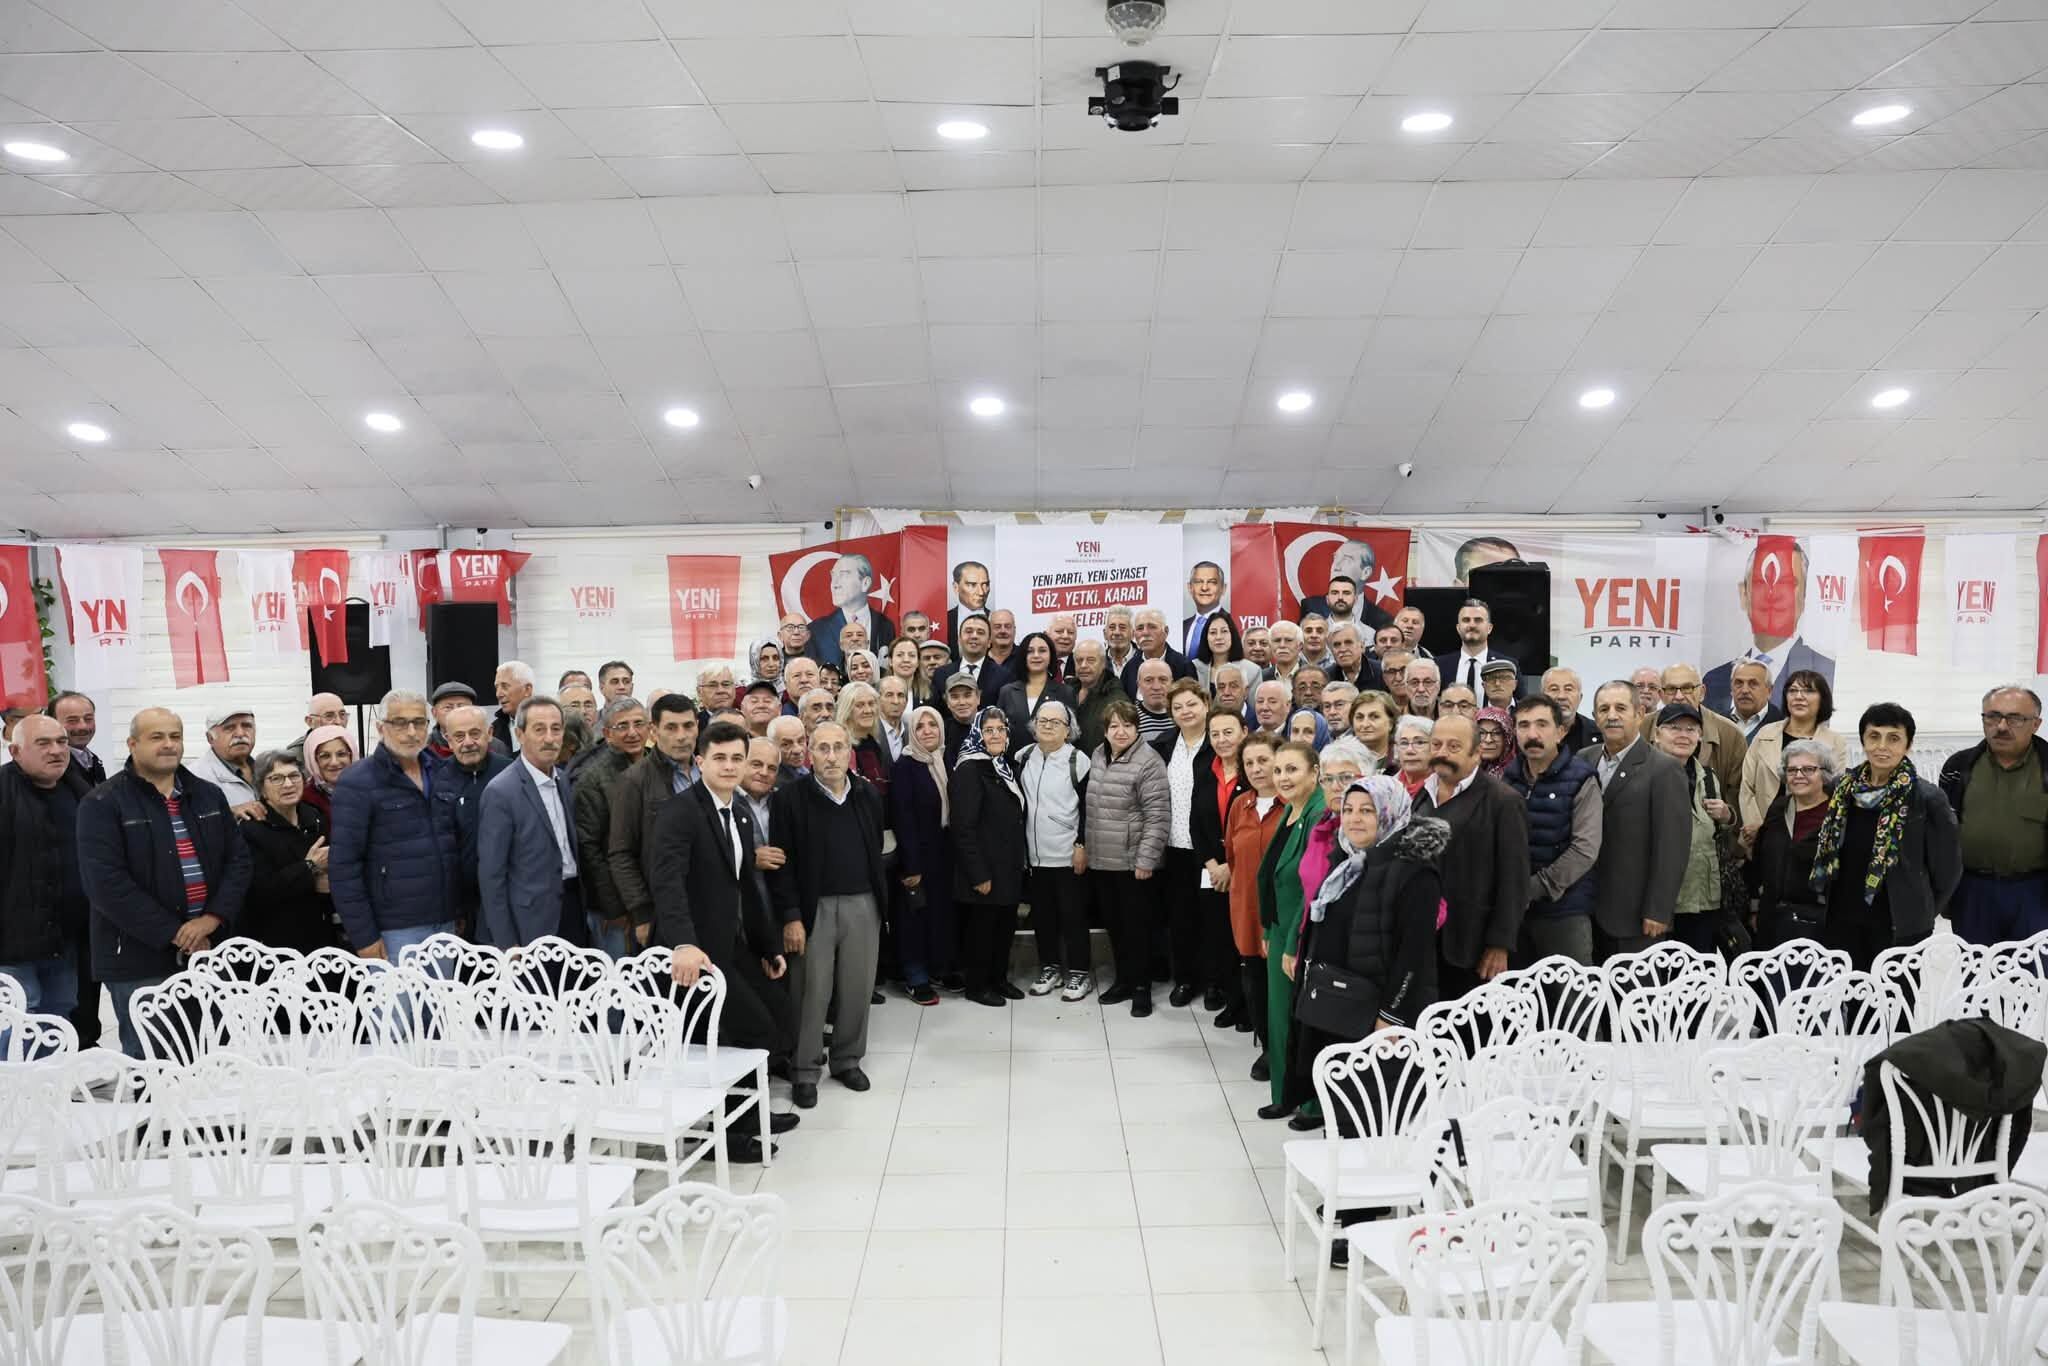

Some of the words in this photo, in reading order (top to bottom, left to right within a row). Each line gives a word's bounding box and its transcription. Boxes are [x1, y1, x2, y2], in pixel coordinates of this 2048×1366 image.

[464, 579, 497, 588] PART
[1104, 585, 1144, 603] KARAR
[1574, 578, 1681, 631] YENi
[1590, 635, 1671, 648] PARTi
